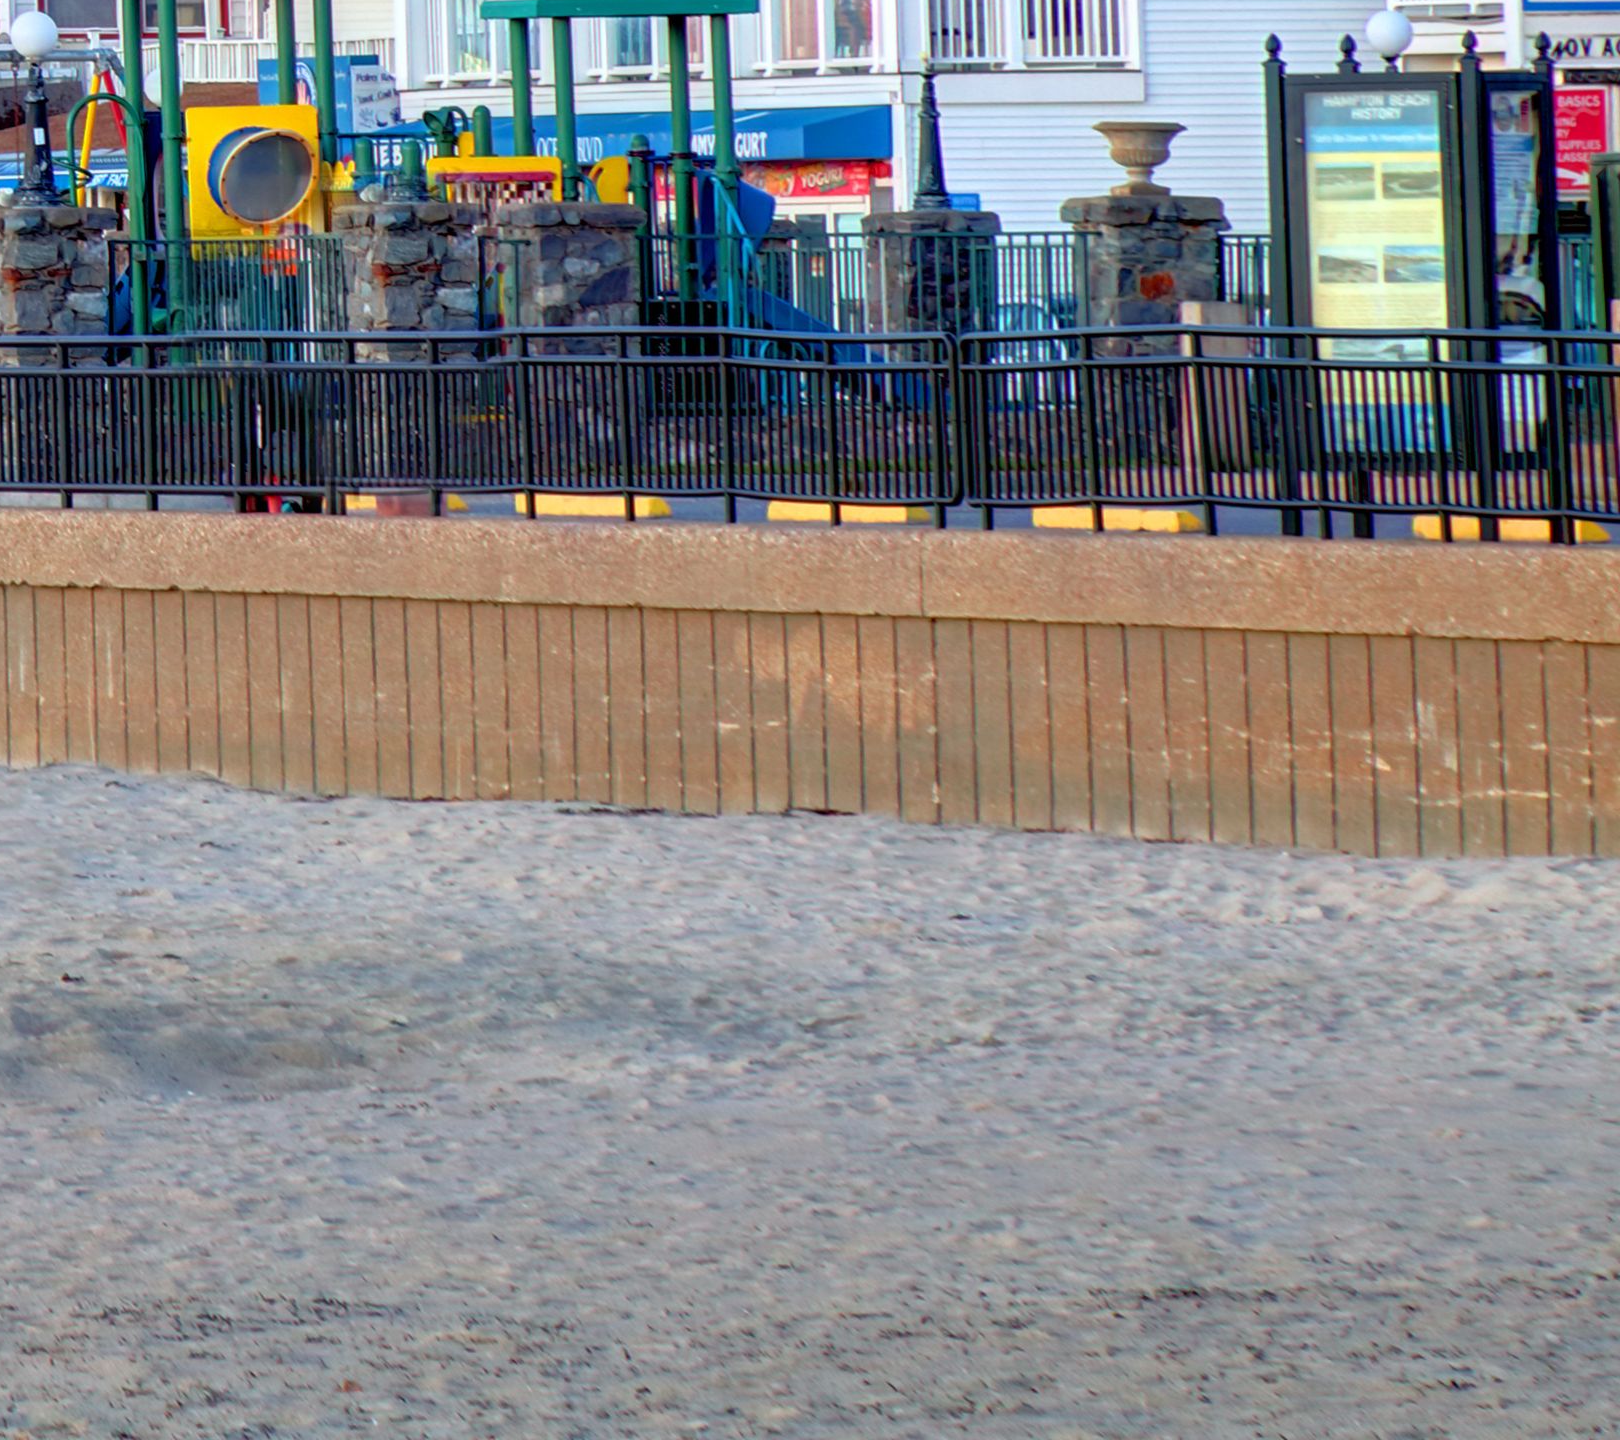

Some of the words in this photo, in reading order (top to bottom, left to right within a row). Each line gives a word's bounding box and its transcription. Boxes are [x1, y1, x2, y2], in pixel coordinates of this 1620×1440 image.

[1323, 94, 1384, 107] HAMPTON
[1388, 93, 1430, 106] BEACH
[1557, 95, 1601, 108] BASICS
[1350, 107, 1401, 119] HISTORY
[576, 136, 603, 163] BLVD
